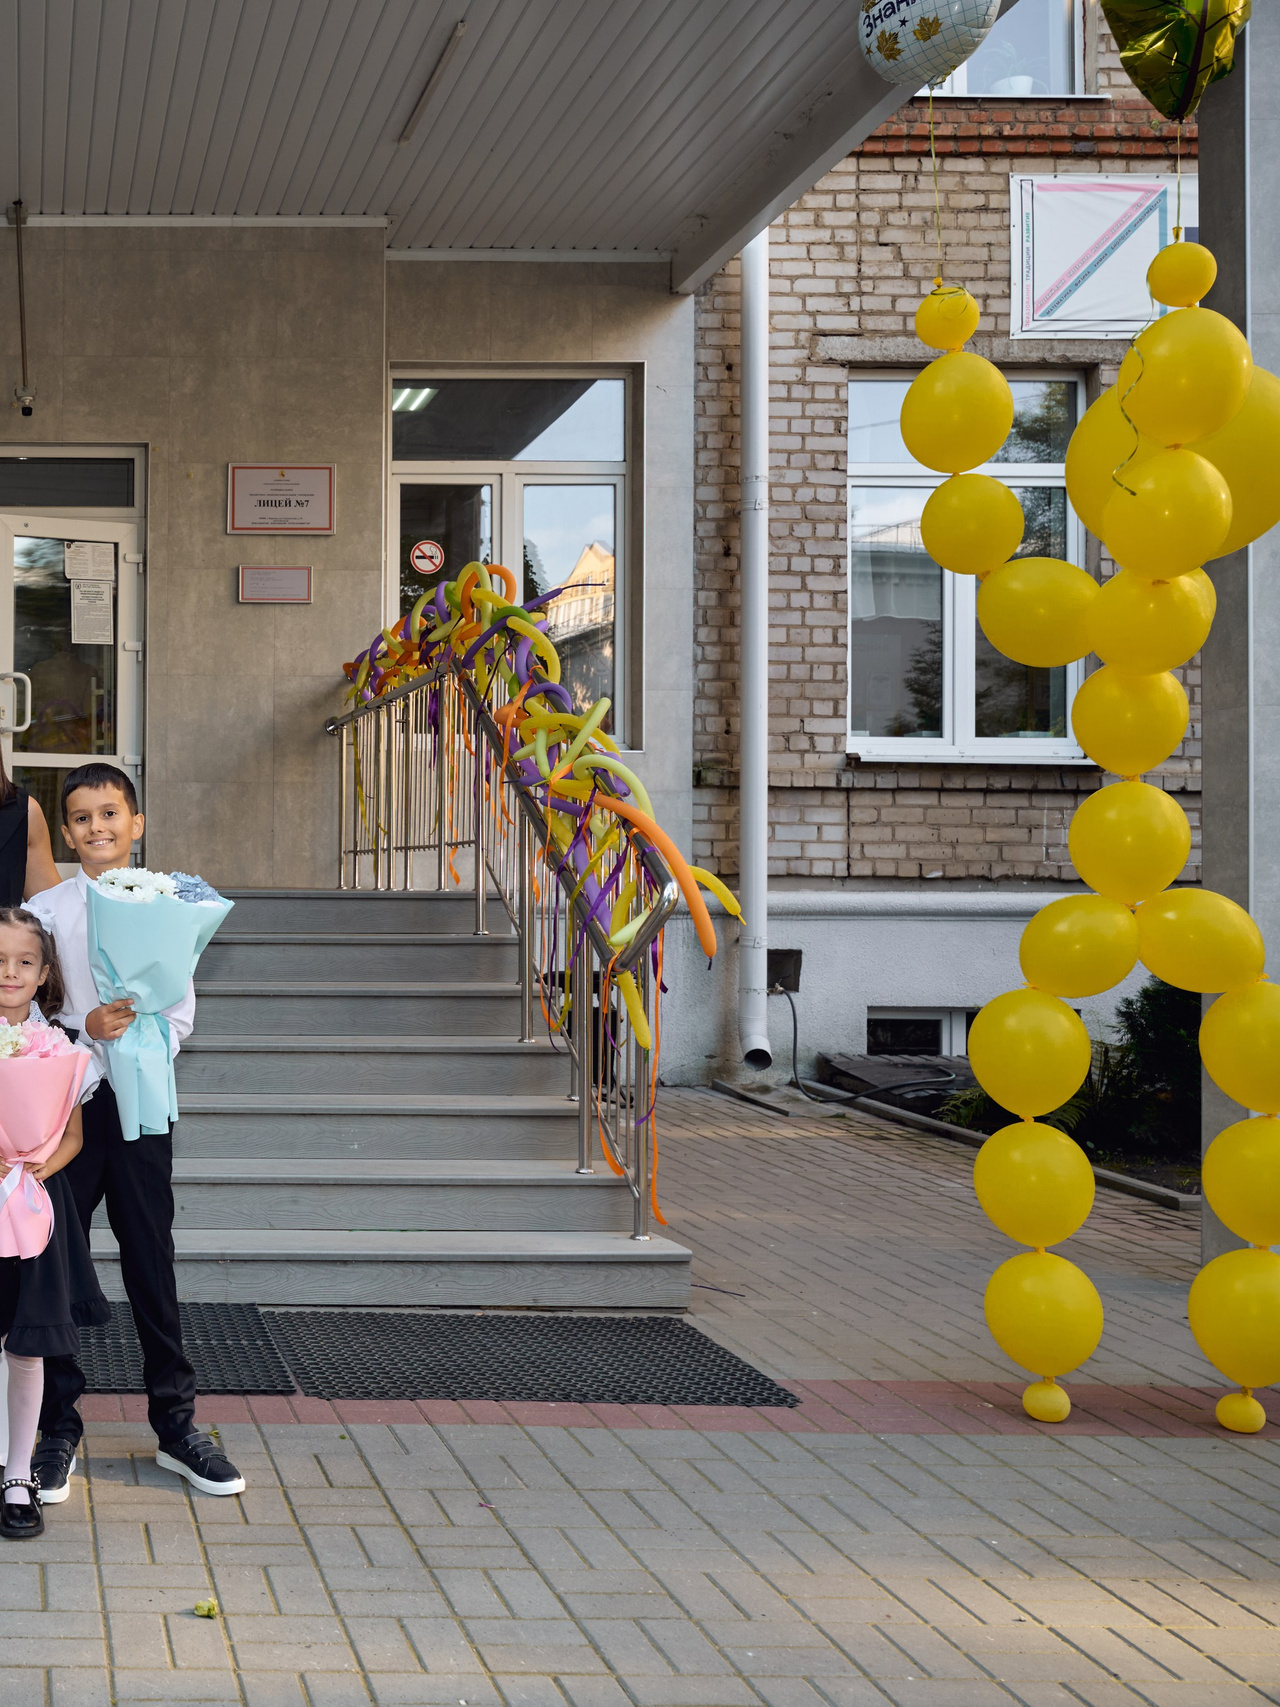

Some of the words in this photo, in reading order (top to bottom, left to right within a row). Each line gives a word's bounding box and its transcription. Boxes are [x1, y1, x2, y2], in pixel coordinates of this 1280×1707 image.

[1045, 289, 1073, 316] МАТЕМАТИКА
[1074, 270, 1091, 287] ФИЗИКА
[1093, 253, 1108, 268] ХИМИЯ
[1110, 229, 1132, 250] БИОЛОГИЯ
[1133, 198, 1162, 228] ИНФОРМАТИКА
[254, 498, 292, 509] ЛИЦЕЙ
[293, 499, 310, 508] №7
